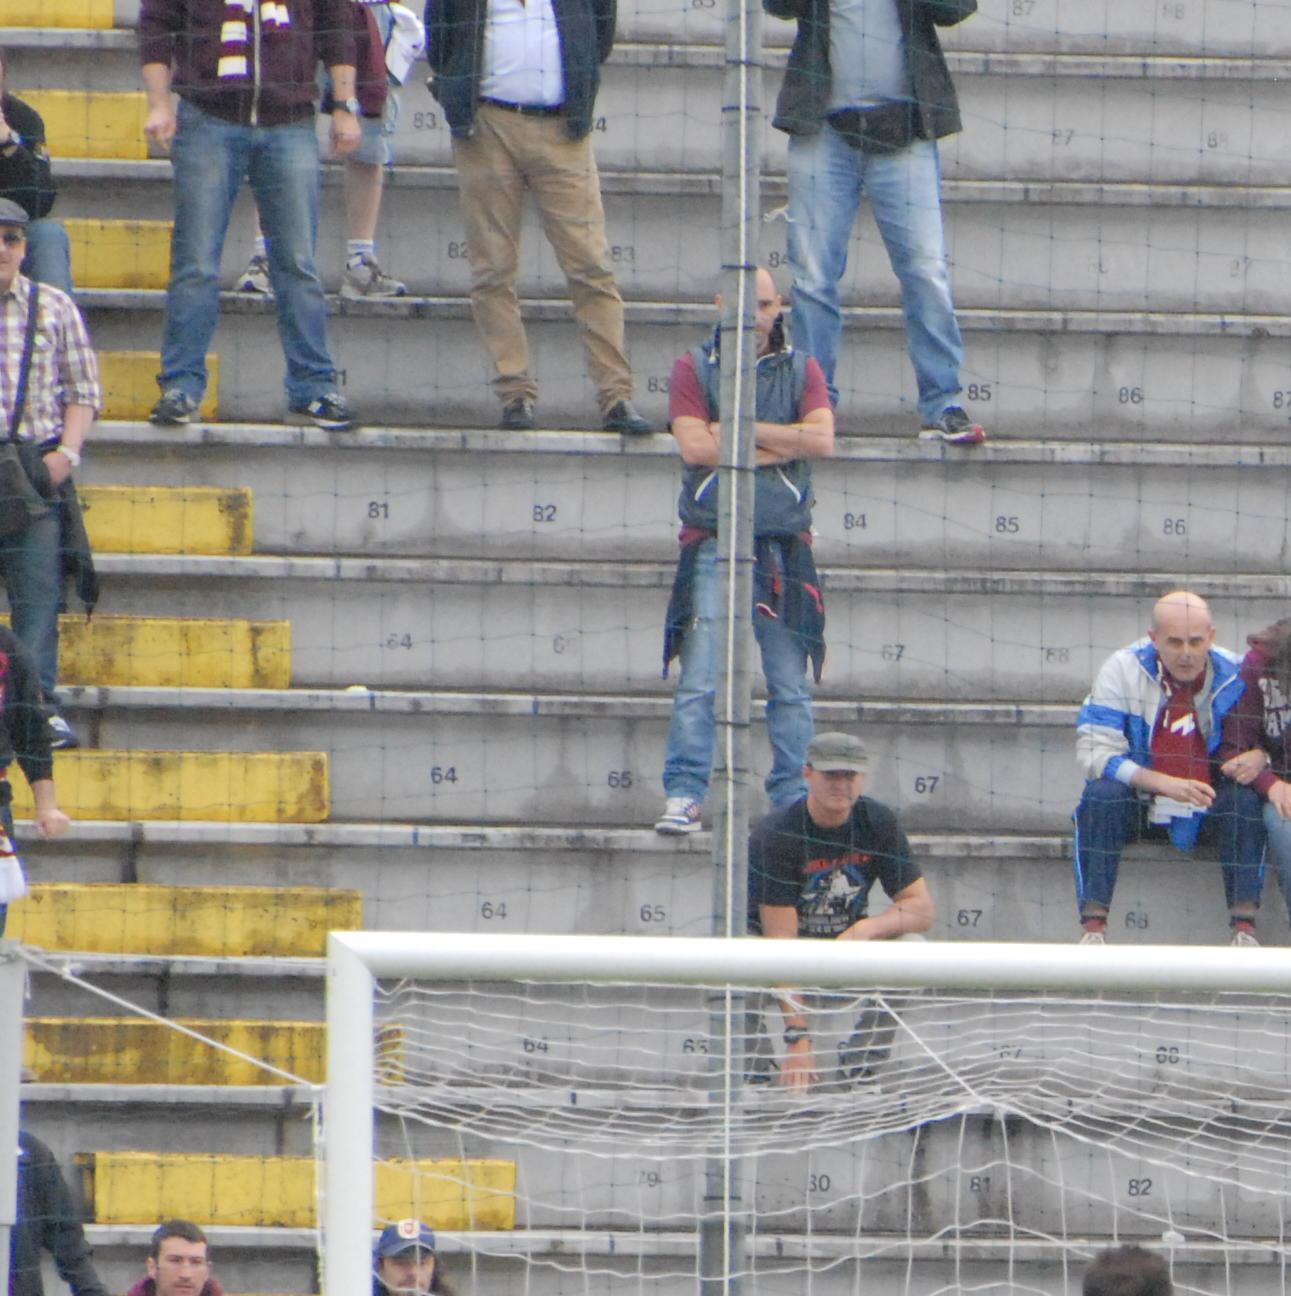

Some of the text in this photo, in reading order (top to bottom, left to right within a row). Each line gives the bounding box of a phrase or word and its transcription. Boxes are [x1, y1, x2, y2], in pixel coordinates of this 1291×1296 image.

[966, 382, 992, 404] 85
[1119, 387, 1146, 405] 86
[368, 501, 390, 520] 81
[533, 504, 558, 524] 82
[843, 512, 868, 532] 84
[995, 516, 1020, 534] 85
[1164, 519, 1187, 535] 86
[430, 765, 459, 786] 64
[608, 769, 635, 792] 65
[915, 776, 940, 794] 67
[480, 901, 508, 921] 64
[640, 905, 667, 923] 65
[956, 910, 983, 928] 67
[1128, 1178, 1154, 1198] 82
